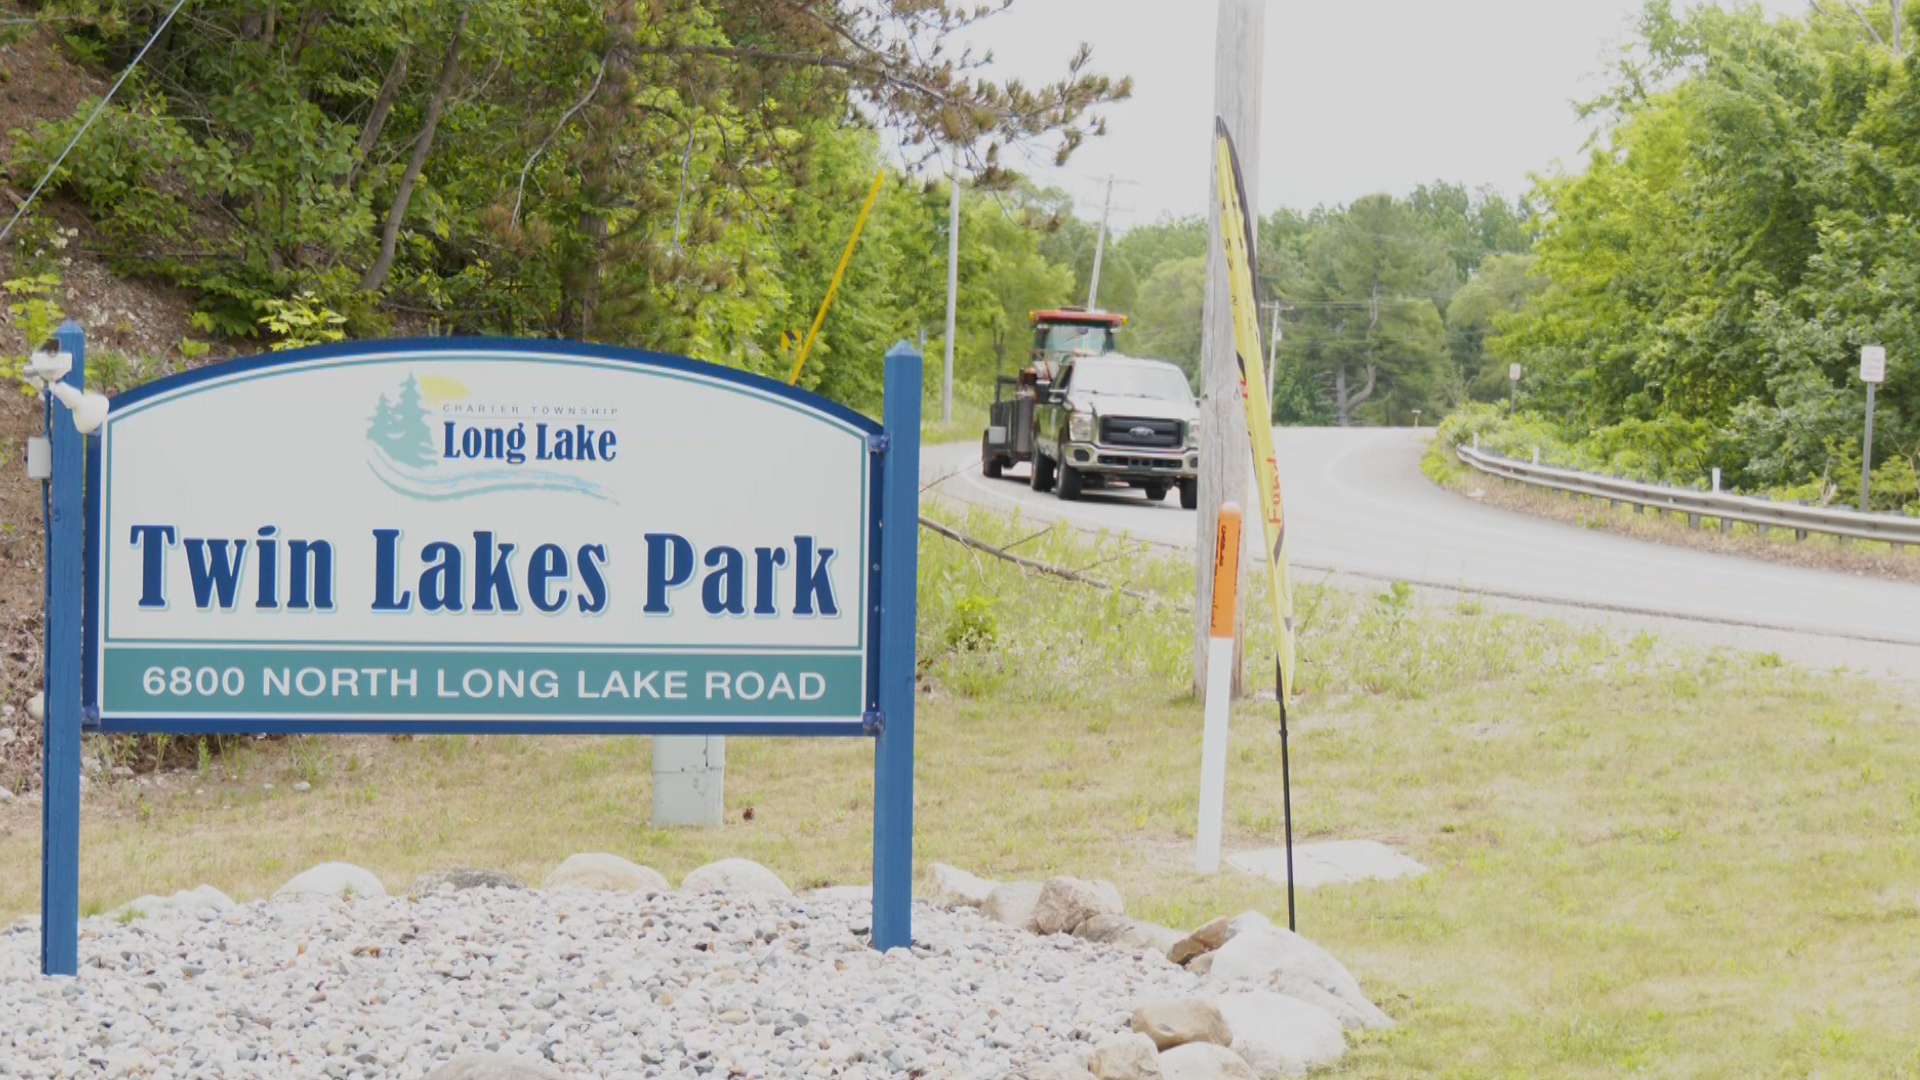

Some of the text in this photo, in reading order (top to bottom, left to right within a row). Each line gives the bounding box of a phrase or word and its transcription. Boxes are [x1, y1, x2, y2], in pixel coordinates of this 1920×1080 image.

[443, 404, 618, 415] CHARTER TOWNSHIP
[443, 420, 617, 464] Long Lake
[130, 524, 839, 616] Twin Lakes Park
[142, 666, 827, 701] 6800 NORTH LONG LAKE ROAD
